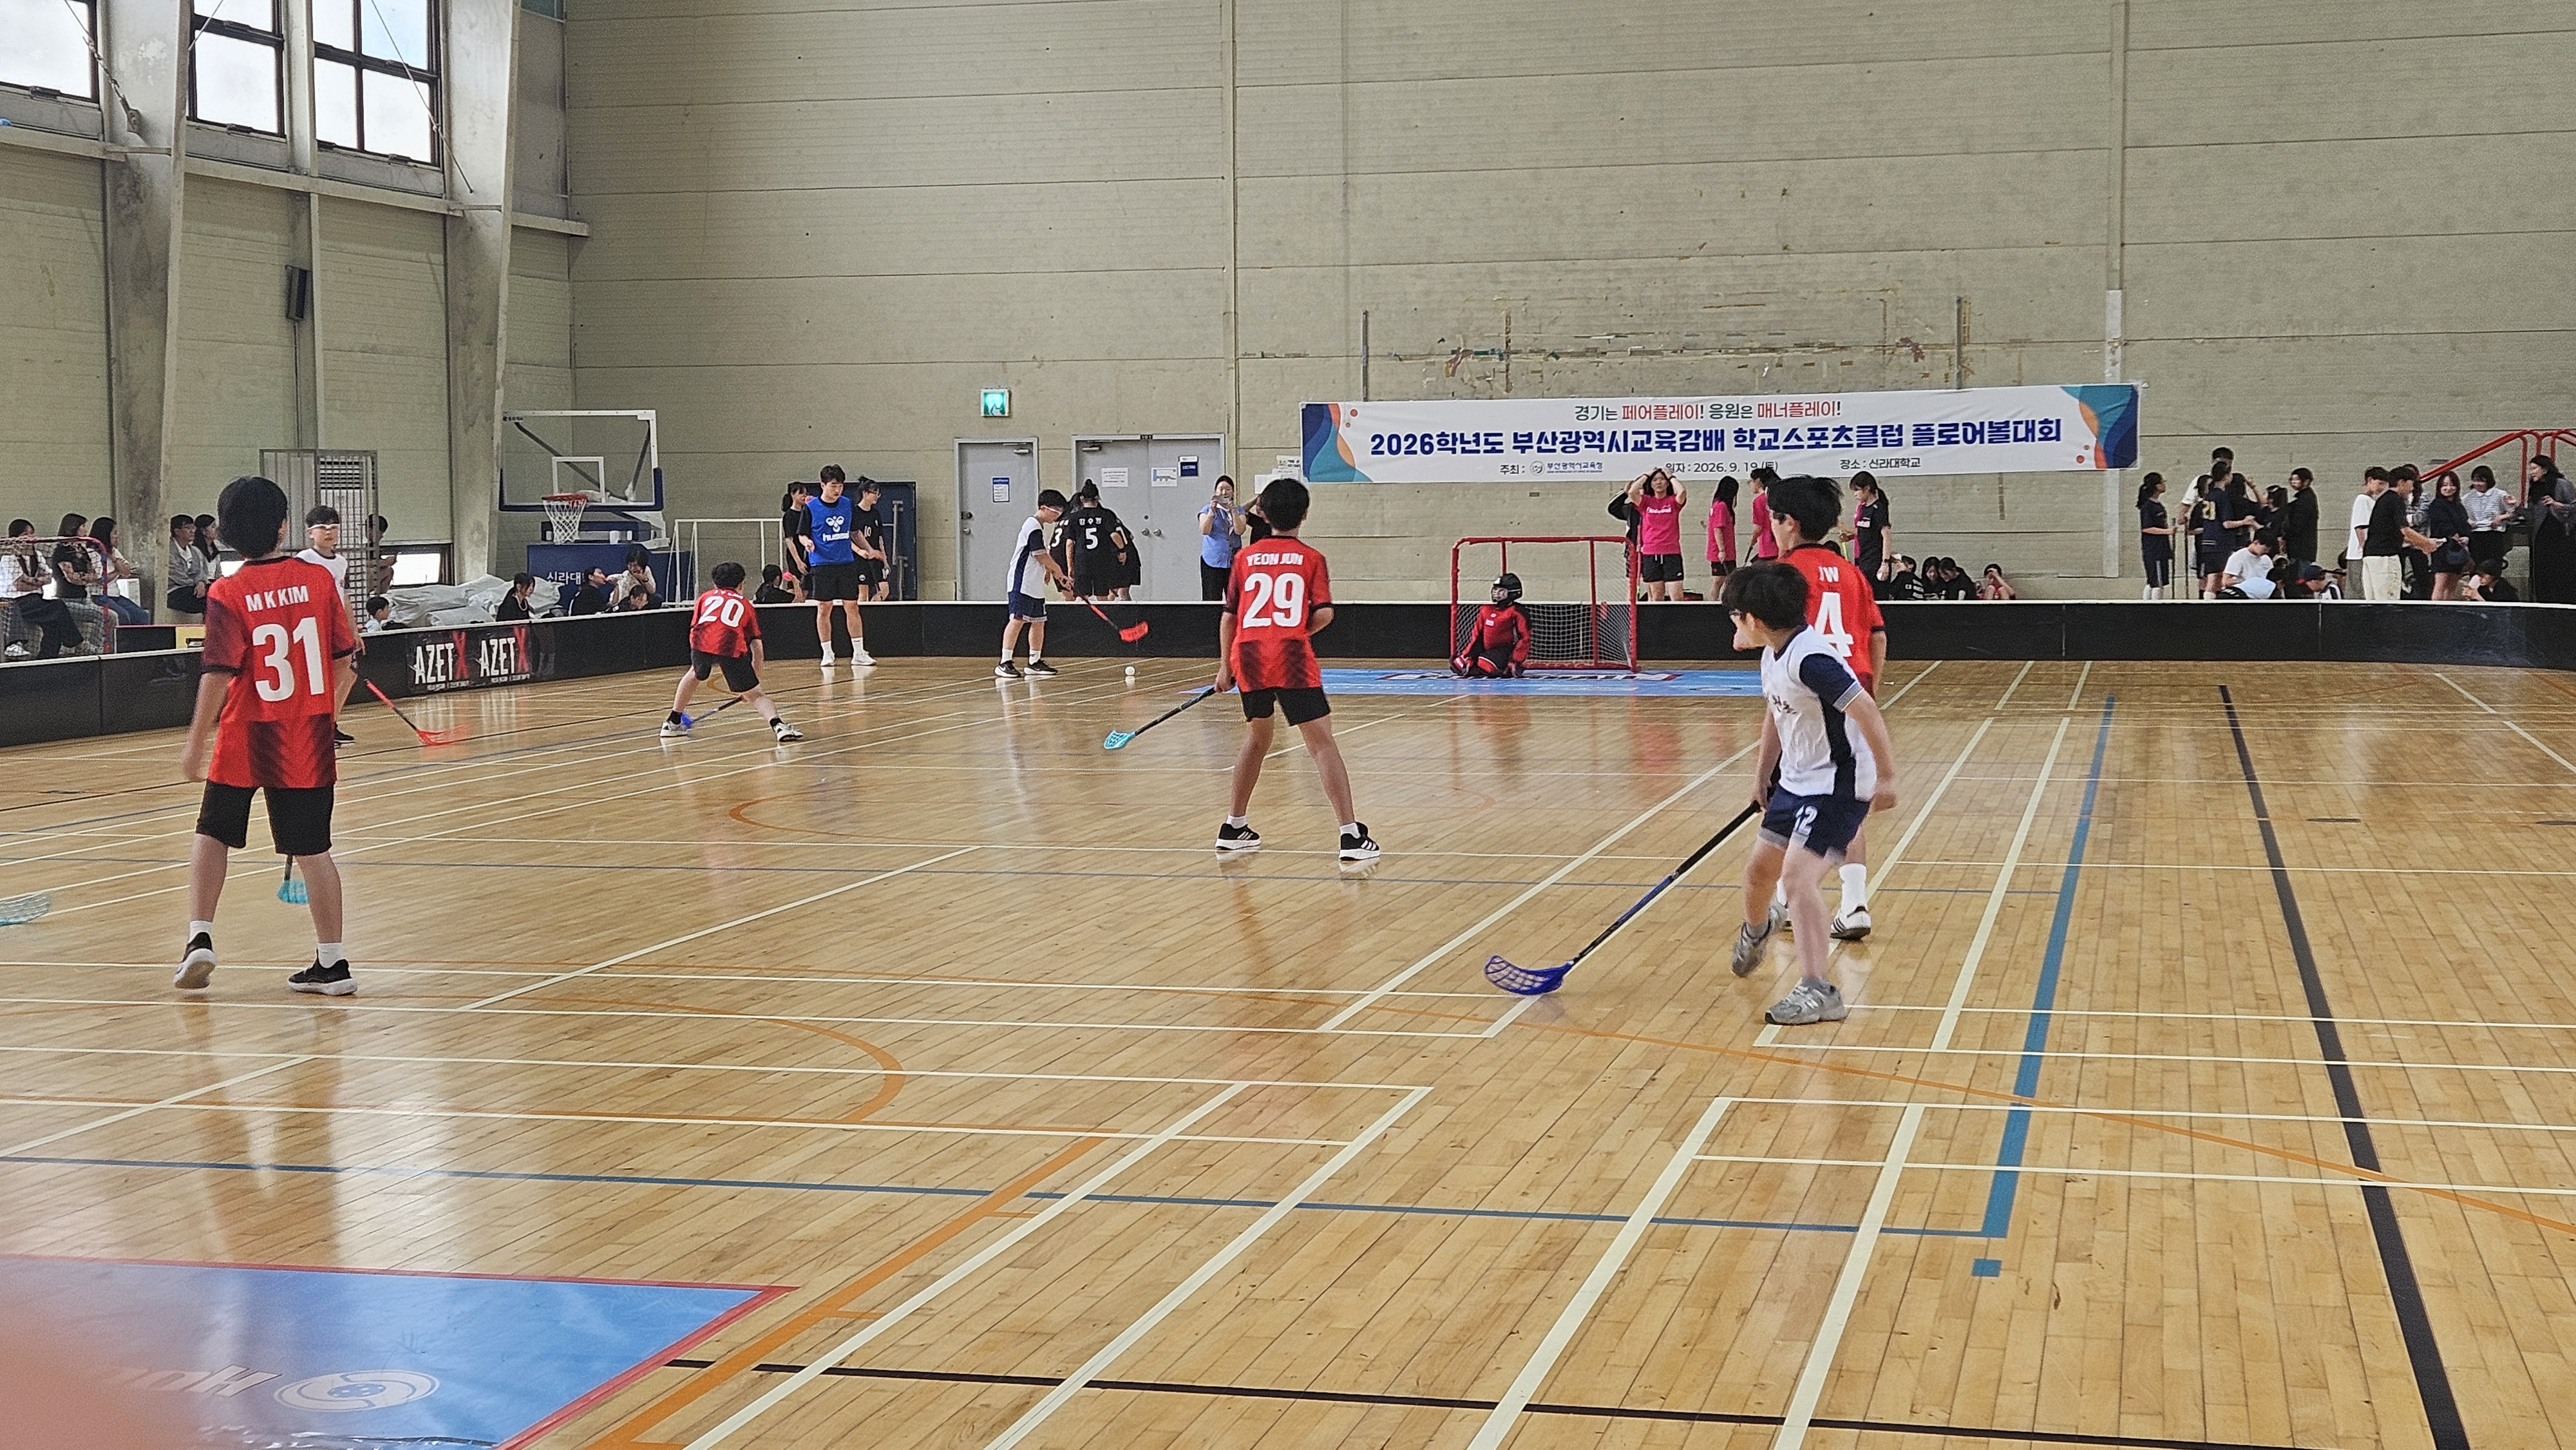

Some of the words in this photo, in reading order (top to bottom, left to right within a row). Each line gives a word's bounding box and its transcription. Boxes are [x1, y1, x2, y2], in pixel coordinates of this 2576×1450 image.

[1575, 405, 1618, 421] 경기는
[1622, 404, 1704, 420] 페어플레이!
[1709, 402, 1753, 420] 응원은
[1757, 400, 1841, 418] 매너플레이!
[1370, 431, 1504, 456] 2026학년도
[1512, 428, 1725, 454] 부산광역시교육감배
[1733, 424, 1903, 451] 학교스포츠클럽
[1912, 418, 2061, 447] 플로어볼대회
[1500, 464, 1519, 475] 주최
[1547, 462, 1603, 470] 부산광역시교육청
[1840, 458, 1861, 470] 장소
[1868, 457, 1921, 469] 신라대학교
[1085, 527, 1099, 550] 5
[1246, 552, 1280, 567] YEON
[546, 571, 585, 585] 신라대
[698, 596, 744, 628] 20
[1243, 572, 1305, 629] 29
[1814, 591, 1854, 657] 4
[252, 616, 325, 702] 31
[1794, 804, 1818, 836] 12
